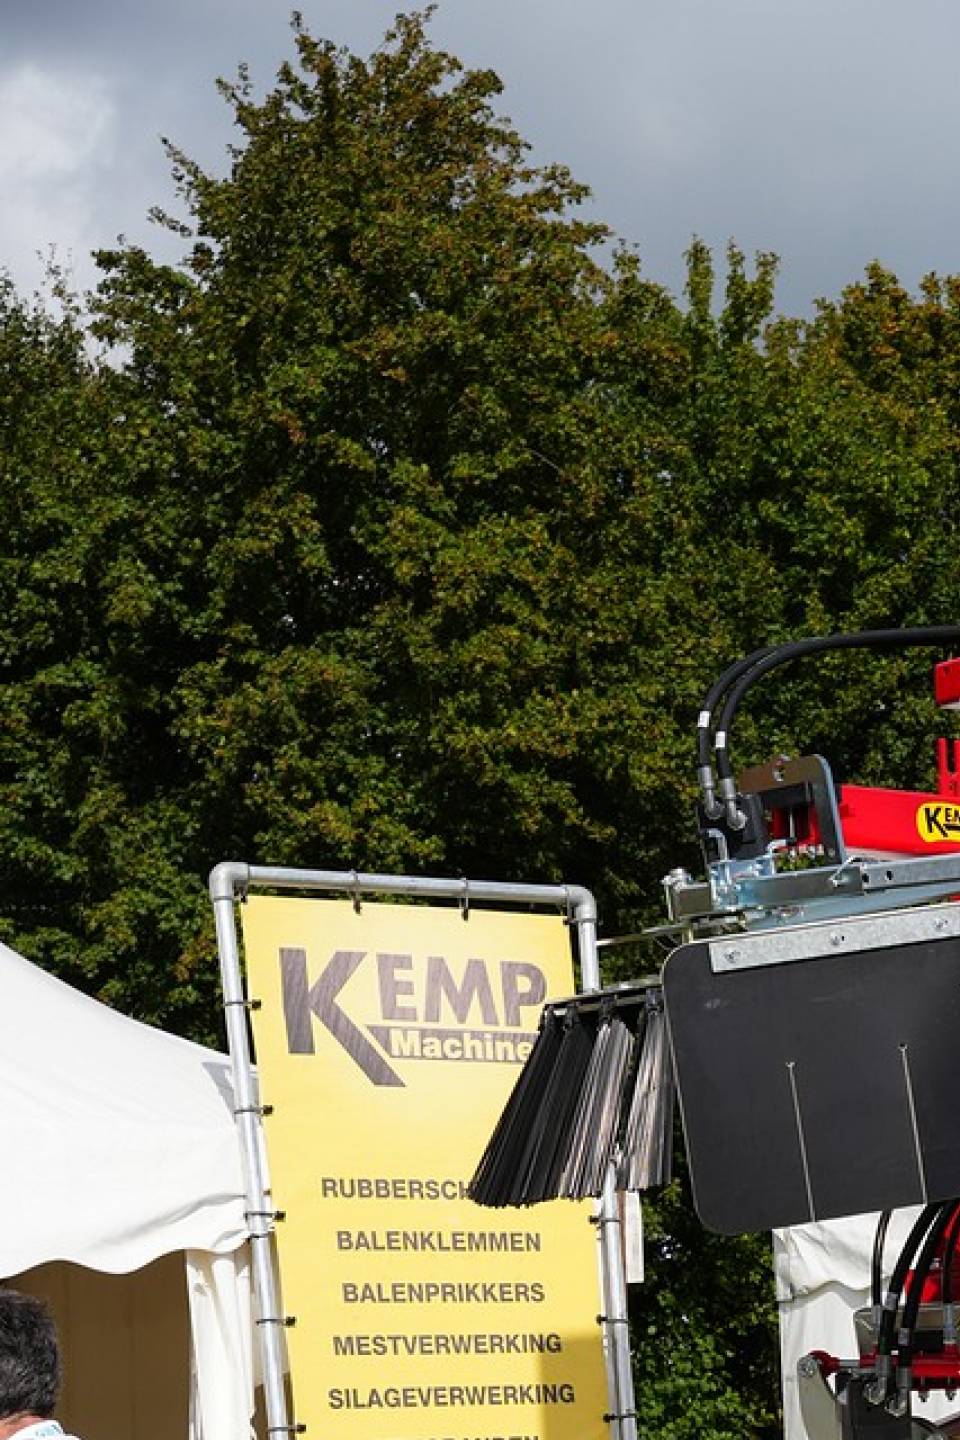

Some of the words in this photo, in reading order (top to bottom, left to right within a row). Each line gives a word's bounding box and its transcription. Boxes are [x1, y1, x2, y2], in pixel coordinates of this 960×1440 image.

[278, 946, 548, 1088] KEMP
[389, 1027, 534, 1061] Machine
[336, 1230, 542, 1252] BALENKLEMMEN
[341, 1282, 546, 1303] BALENPRIKKERS
[332, 1333, 562, 1356] MESTVERWERKING
[328, 1383, 575, 1409] SILAGEVERWERKING
